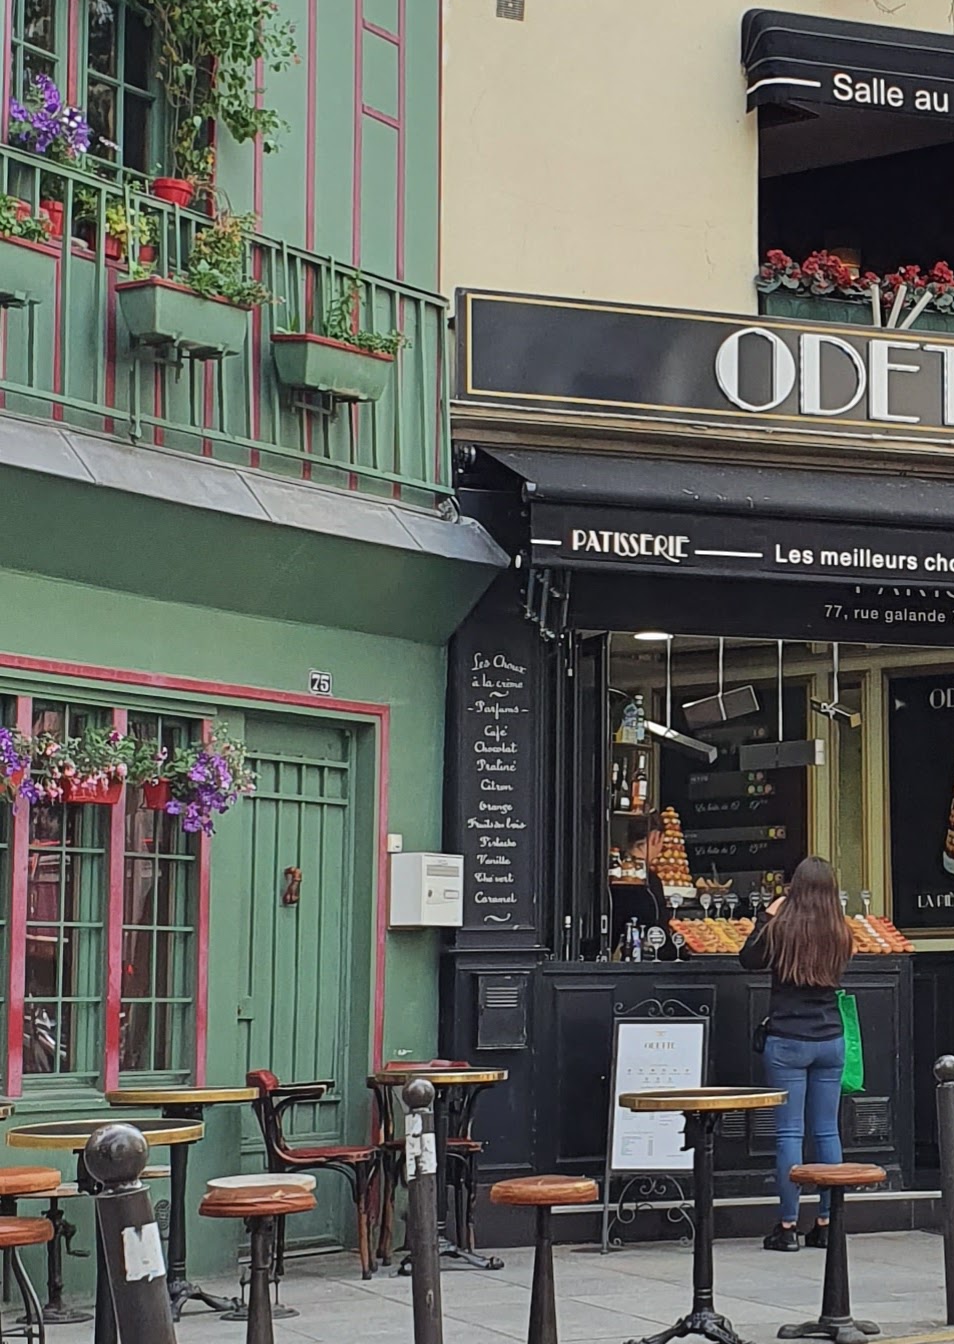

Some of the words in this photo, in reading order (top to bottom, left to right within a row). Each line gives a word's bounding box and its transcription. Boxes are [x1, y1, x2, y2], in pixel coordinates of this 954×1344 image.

[833, 73, 904, 107] Salle
[915, 90, 948, 113] au
[572, 529, 690, 563] PATISSERIE
[775, 544, 814, 564] Les
[821, 548, 918, 570] meilleurs
[824, 604, 848, 620] 77,
[854, 608, 879, 620] rue
[885, 608, 946, 623] galande
[471, 652, 491, 671] Les
[493, 654, 527, 675] Choux
[311, 673, 330, 692] 75
[471, 676, 480, 687] à
[482, 673, 494, 687] la
[484, 724, 508, 742] Café
[474, 741, 518, 753] Chocolat
[476, 758, 517, 771] Praliné
[480, 778, 514, 791] Citron
[479, 800, 513, 814] Orange
[476, 854, 511, 865] Vanille
[475, 891, 518, 903] Caramel
[917, 895, 934, 908] LA
